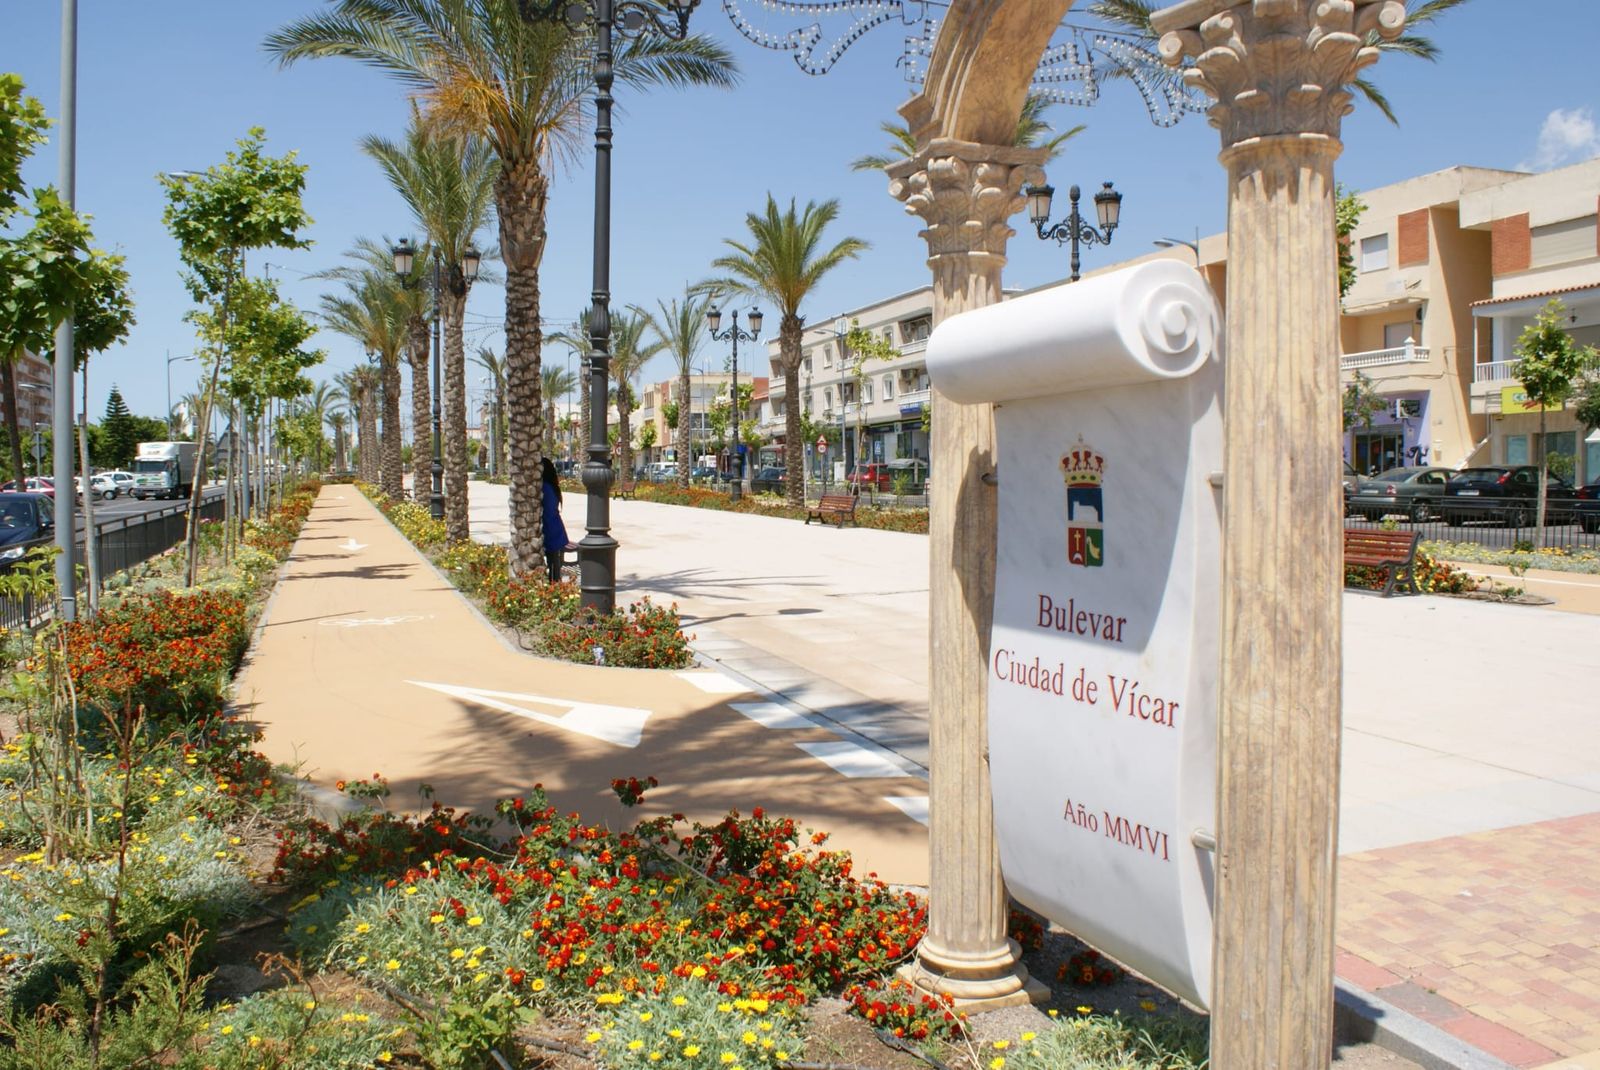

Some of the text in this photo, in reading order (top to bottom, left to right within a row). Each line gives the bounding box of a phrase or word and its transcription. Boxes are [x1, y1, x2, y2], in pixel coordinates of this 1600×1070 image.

[1037, 594, 1127, 642] Bulevar
[994, 649, 1179, 728] Ciudad de Vícar
[1063, 798, 1170, 862] Año MMVI
